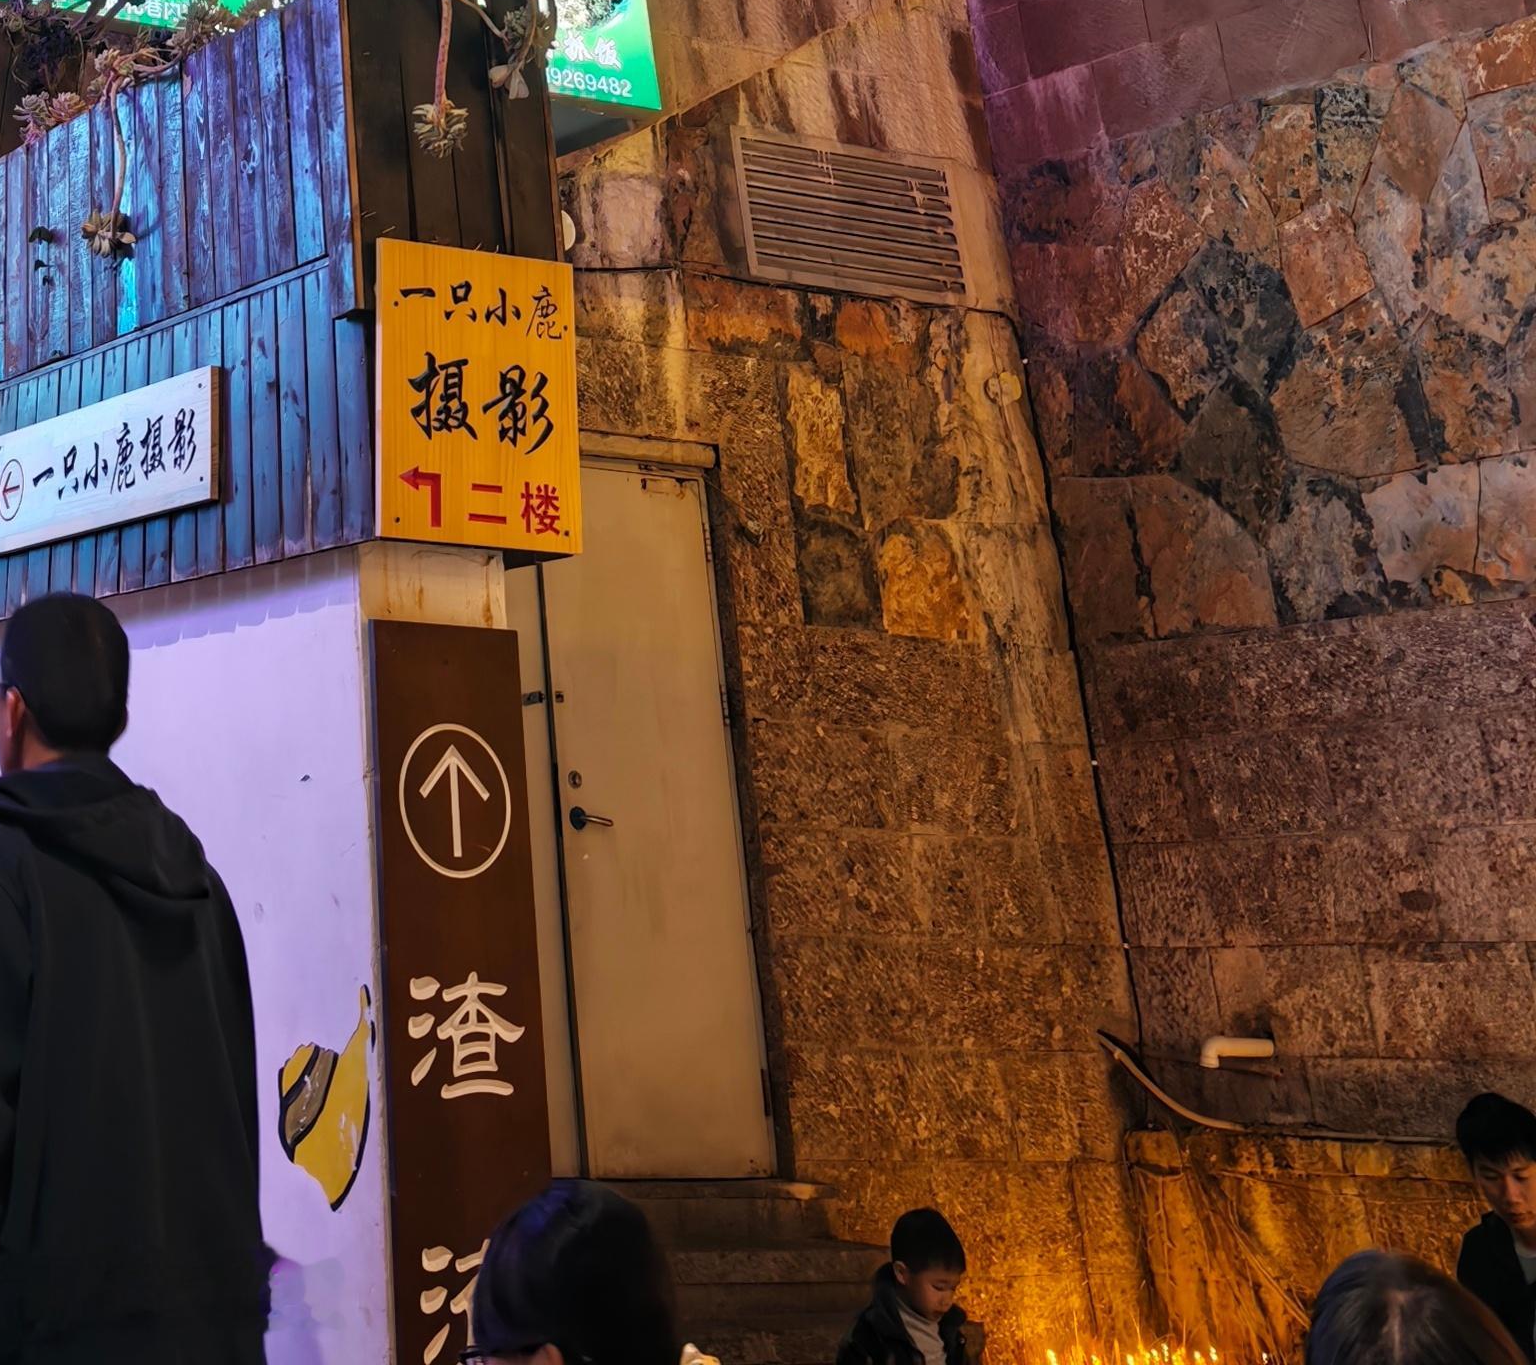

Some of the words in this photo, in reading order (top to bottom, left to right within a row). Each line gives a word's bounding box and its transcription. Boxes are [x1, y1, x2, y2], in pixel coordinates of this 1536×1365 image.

[399, 280, 563, 340] 一只小鹿
[407, 351, 555, 456] 摄影
[32, 407, 197, 501] 一只小鹿摄影
[467, 481, 562, 536] 二楼
